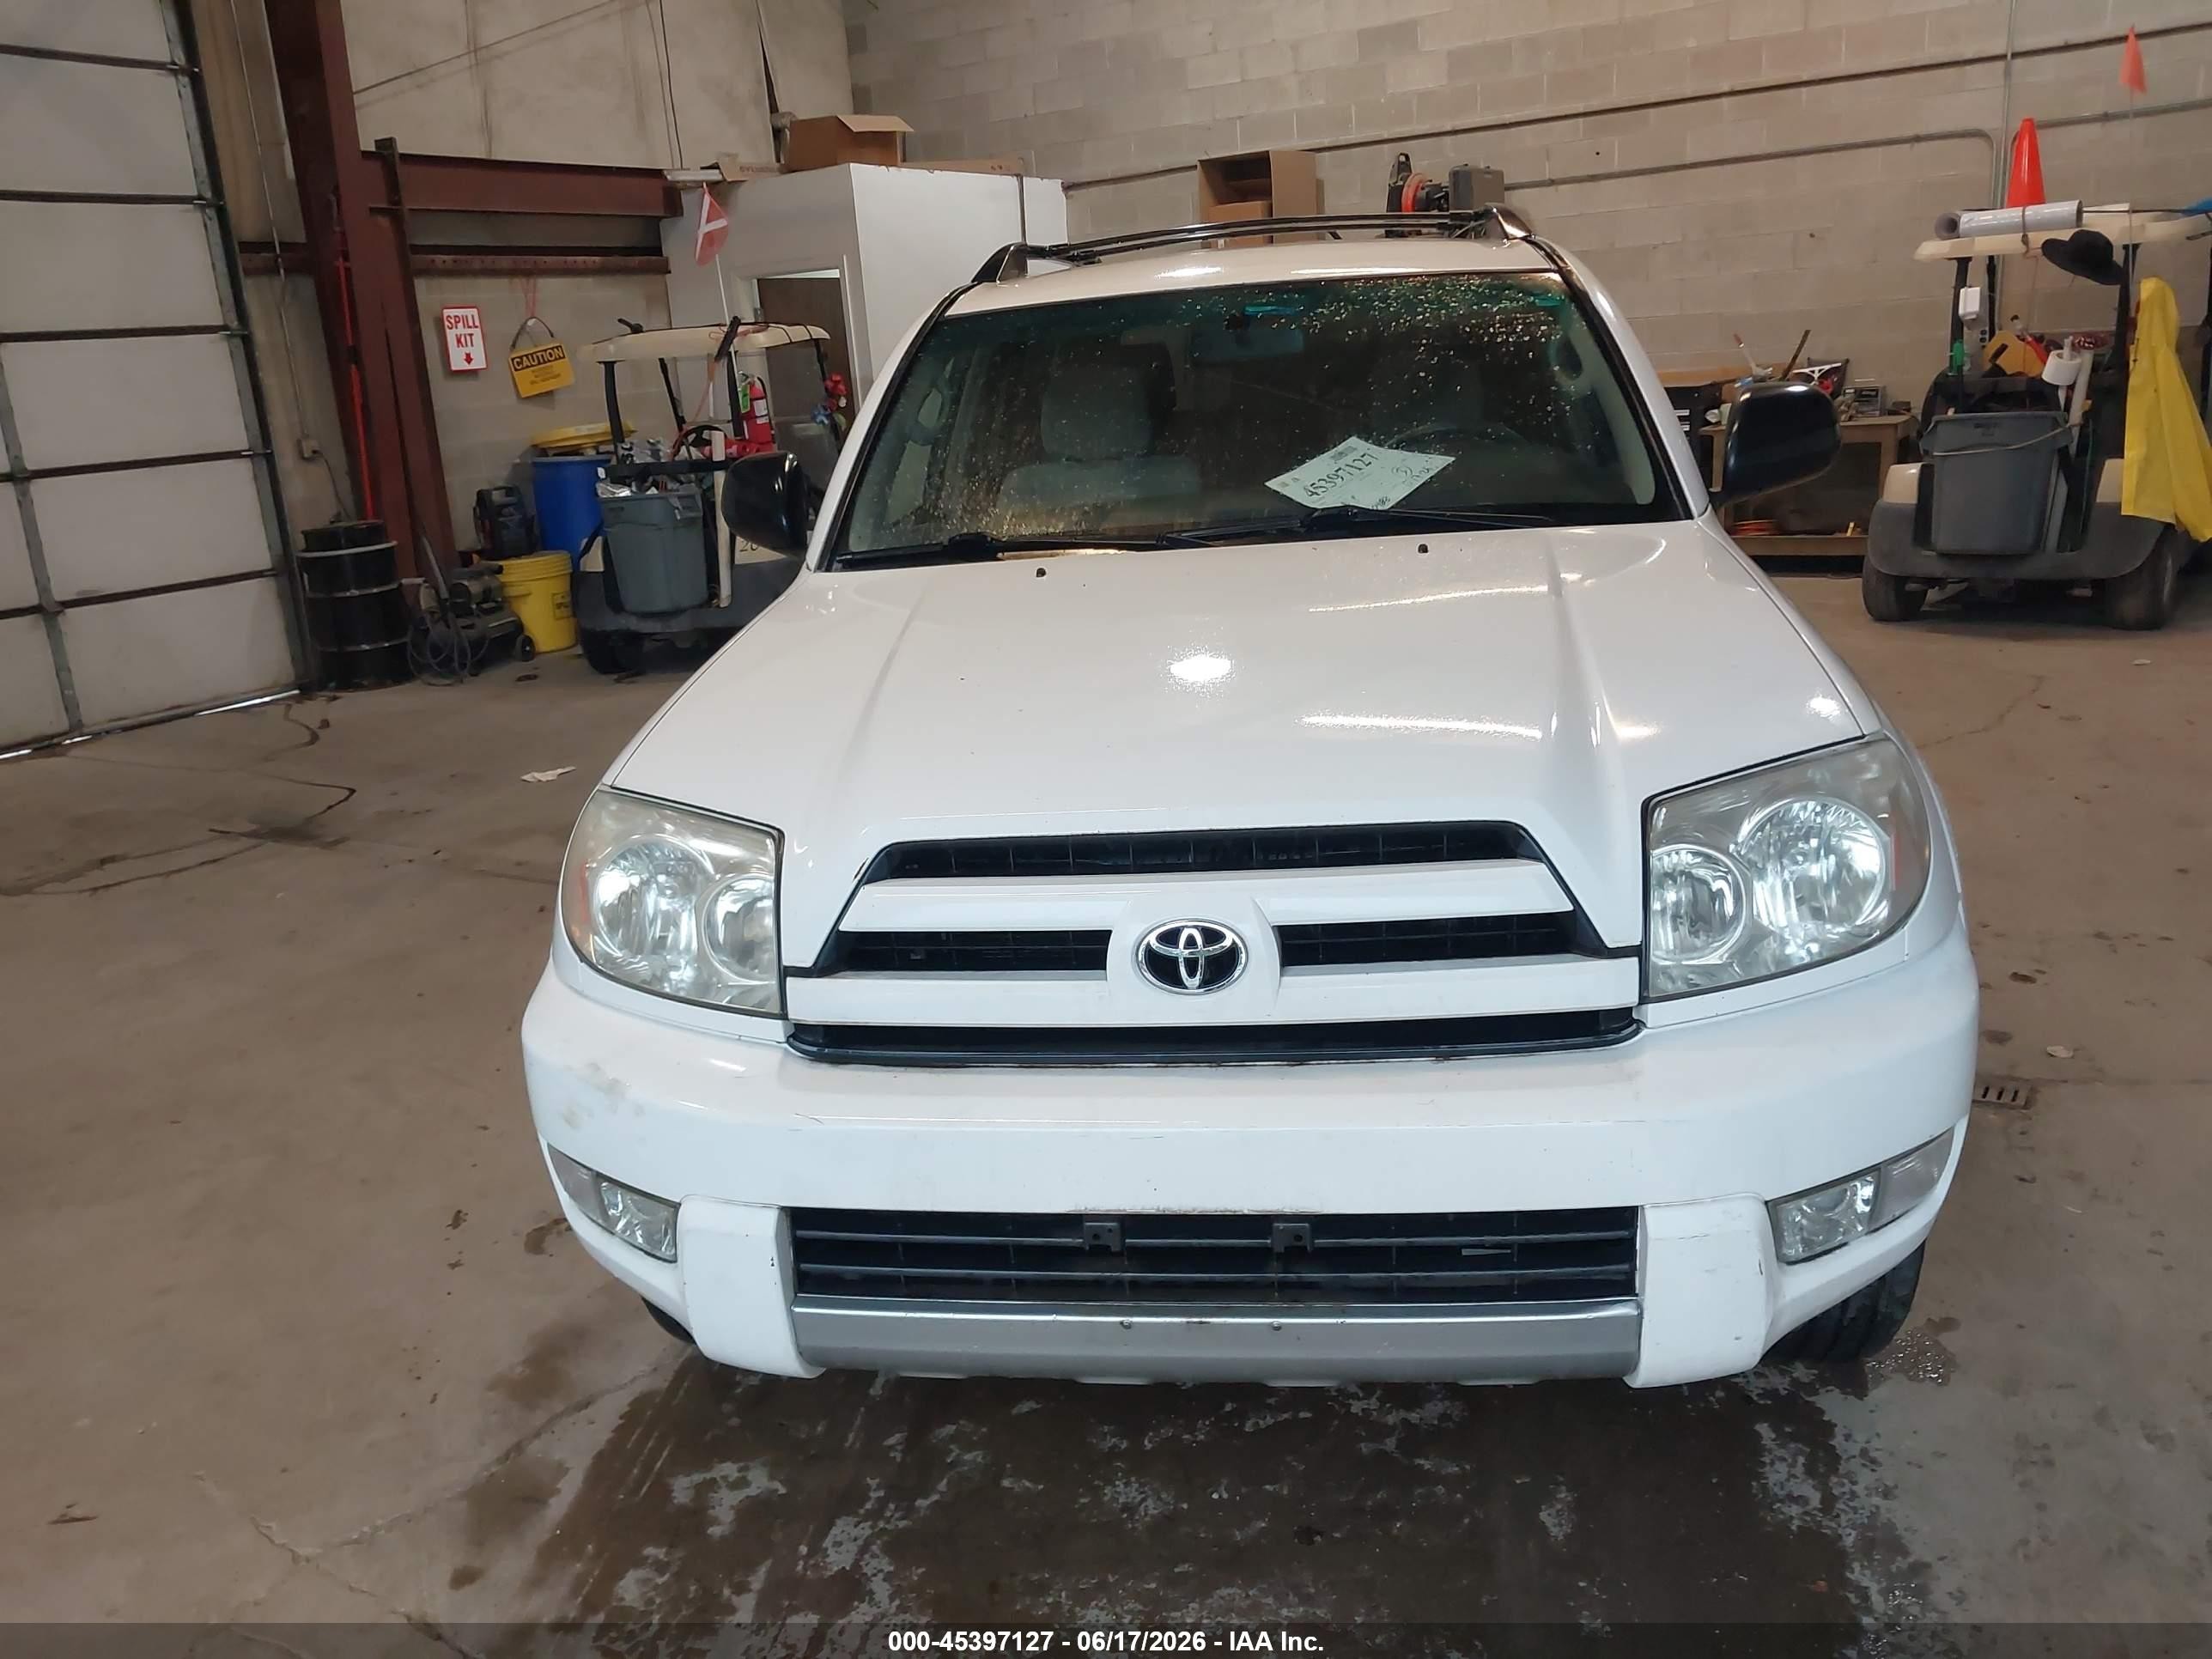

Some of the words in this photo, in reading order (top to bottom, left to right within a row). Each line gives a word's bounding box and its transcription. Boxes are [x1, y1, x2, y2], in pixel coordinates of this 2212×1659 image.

[446, 314, 479, 330] SPILL
[455, 333, 475, 348] KIT
[514, 348, 563, 369] CAUTION
[1304, 453, 1379, 496] 45397127
